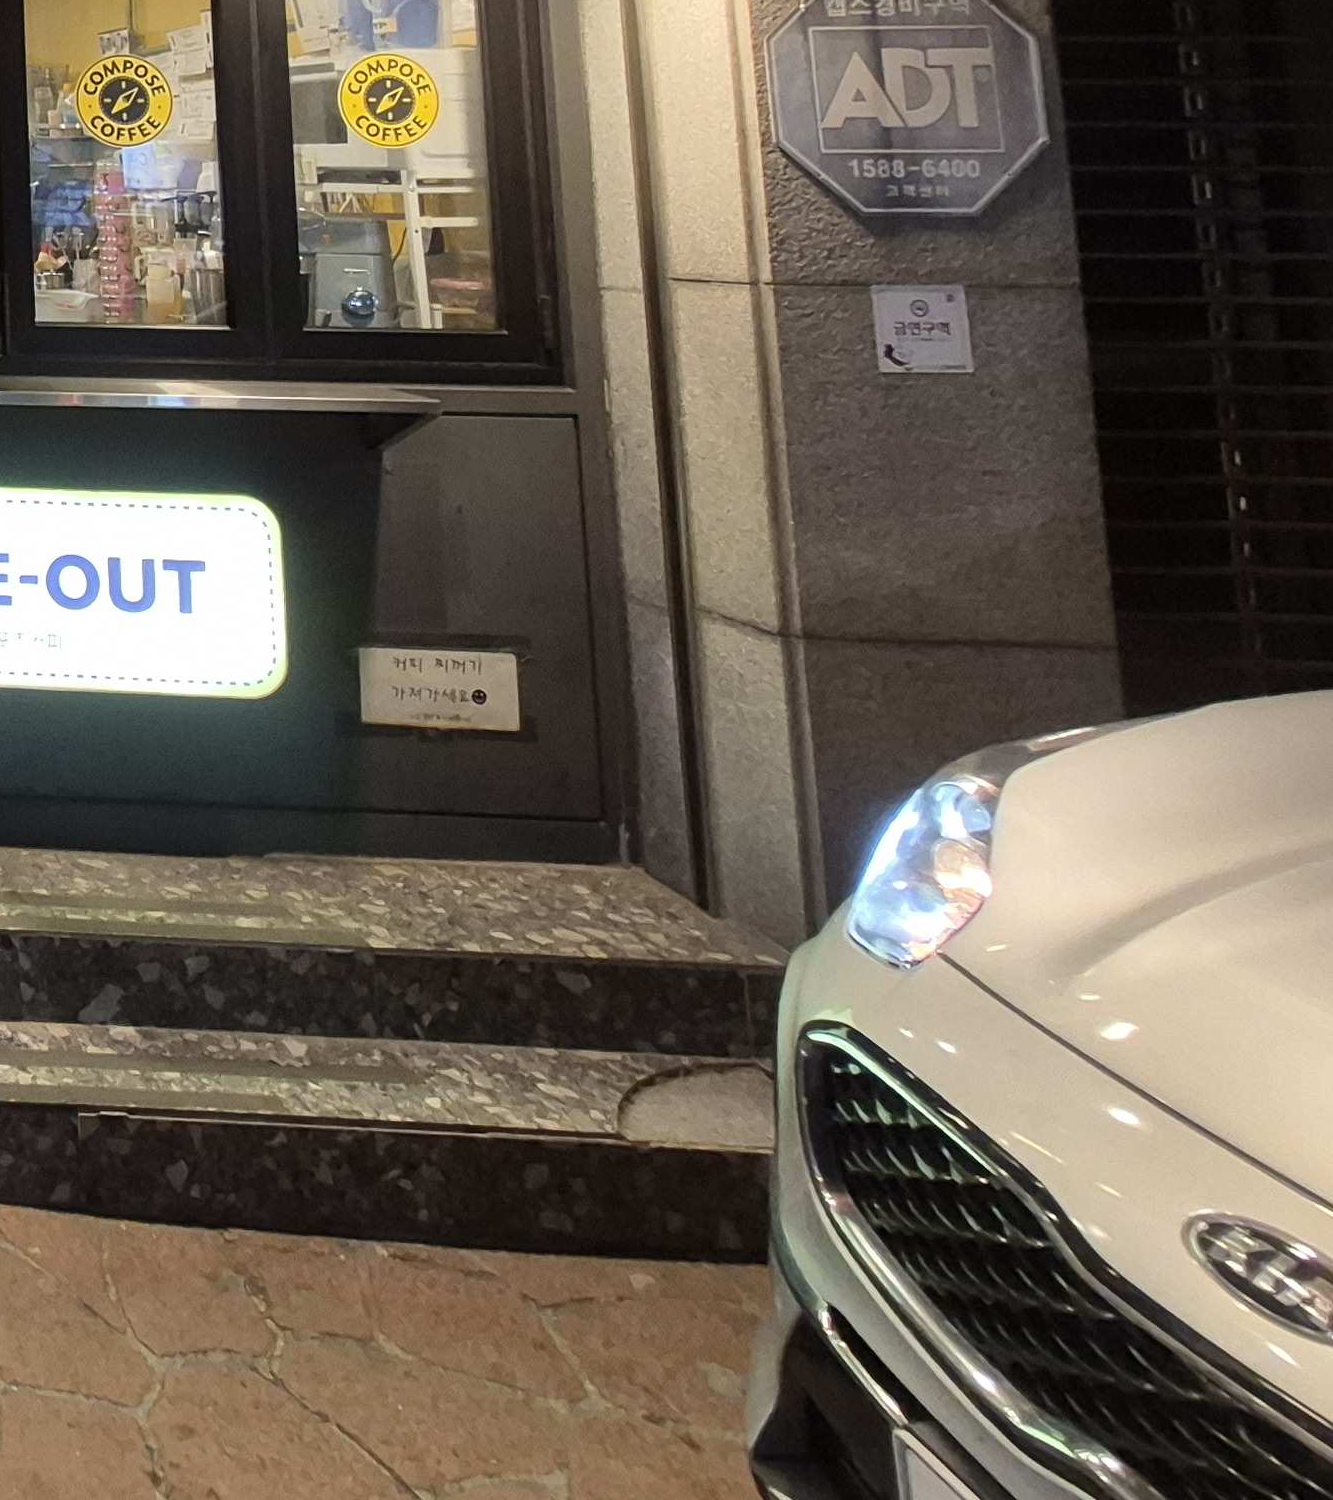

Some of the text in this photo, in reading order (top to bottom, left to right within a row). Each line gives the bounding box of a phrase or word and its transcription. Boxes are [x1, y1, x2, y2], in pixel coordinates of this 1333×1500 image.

[84, 59, 165, 96] COMPOSE
[347, 58, 432, 95] COMPOSE
[821, 47, 994, 128] ADT
[90, 114, 162, 142] COFFEE
[354, 114, 428, 143] COFFEE
[848, 158, 981, 179] 1588-6400
[393, 656, 423, 673] 커피
